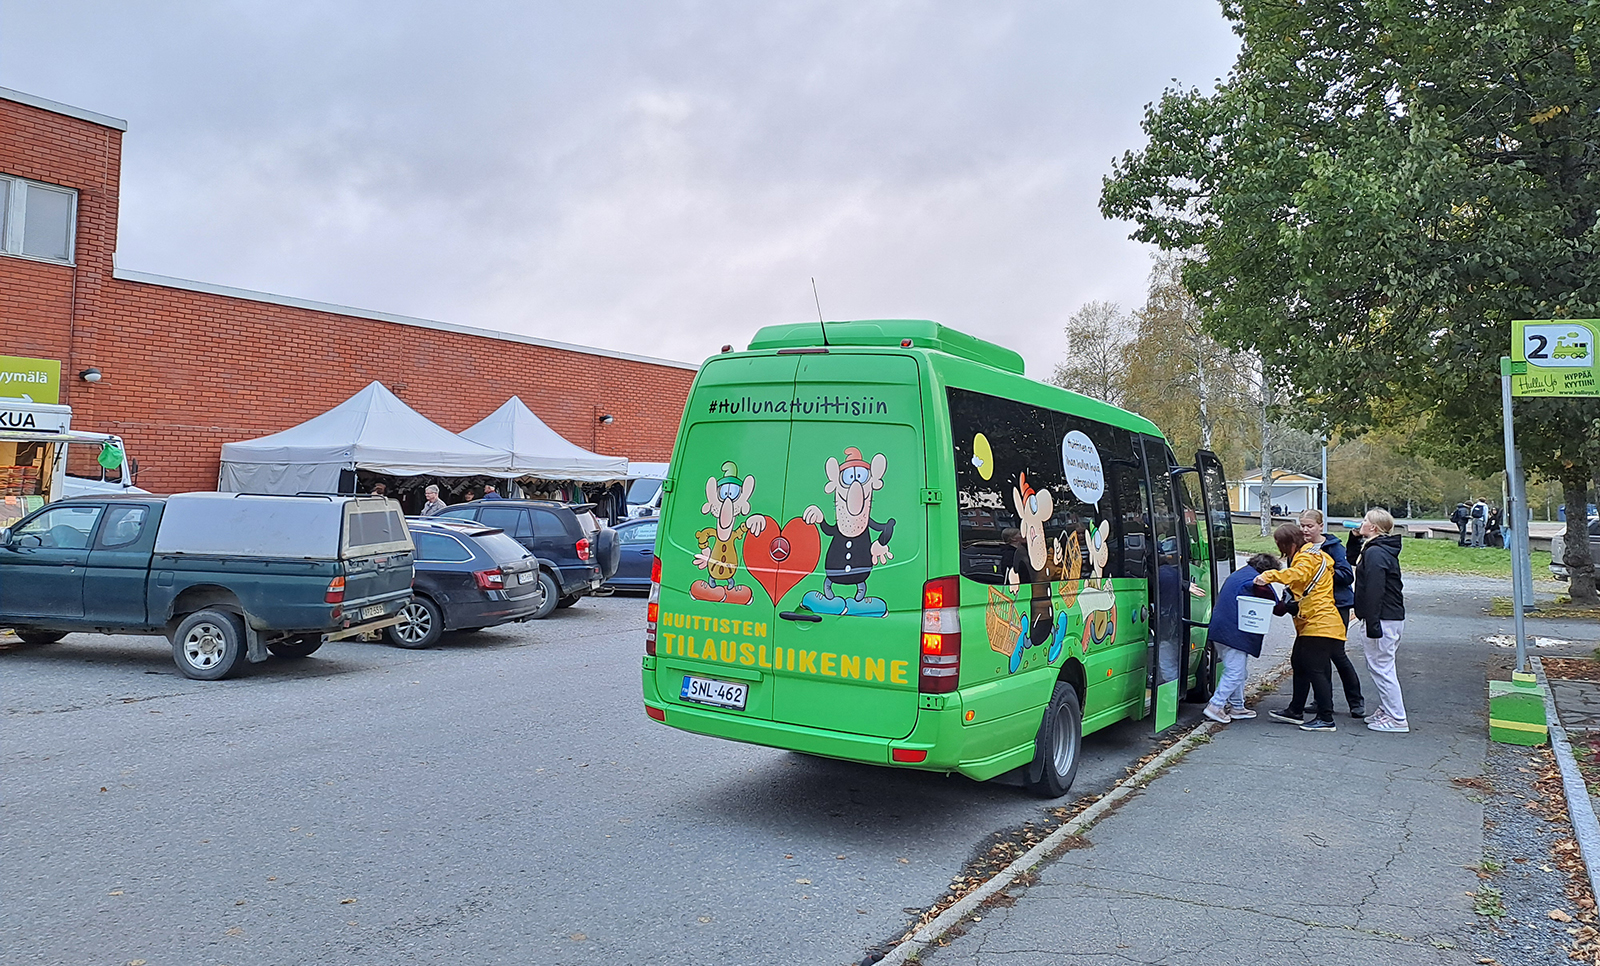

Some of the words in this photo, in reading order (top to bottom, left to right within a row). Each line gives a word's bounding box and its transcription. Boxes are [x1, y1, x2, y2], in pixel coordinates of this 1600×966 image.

[1528, 334, 1548, 359] 2
[1564, 370, 1592, 381] HYPPÄÄ
[1564, 379, 1596, 389] KYYTIIN!
[662, 612, 767, 638] HUITTISTEN
[662, 632, 909, 685] TILAUSLIIKENNE
[691, 680, 743, 703] SNL-462
